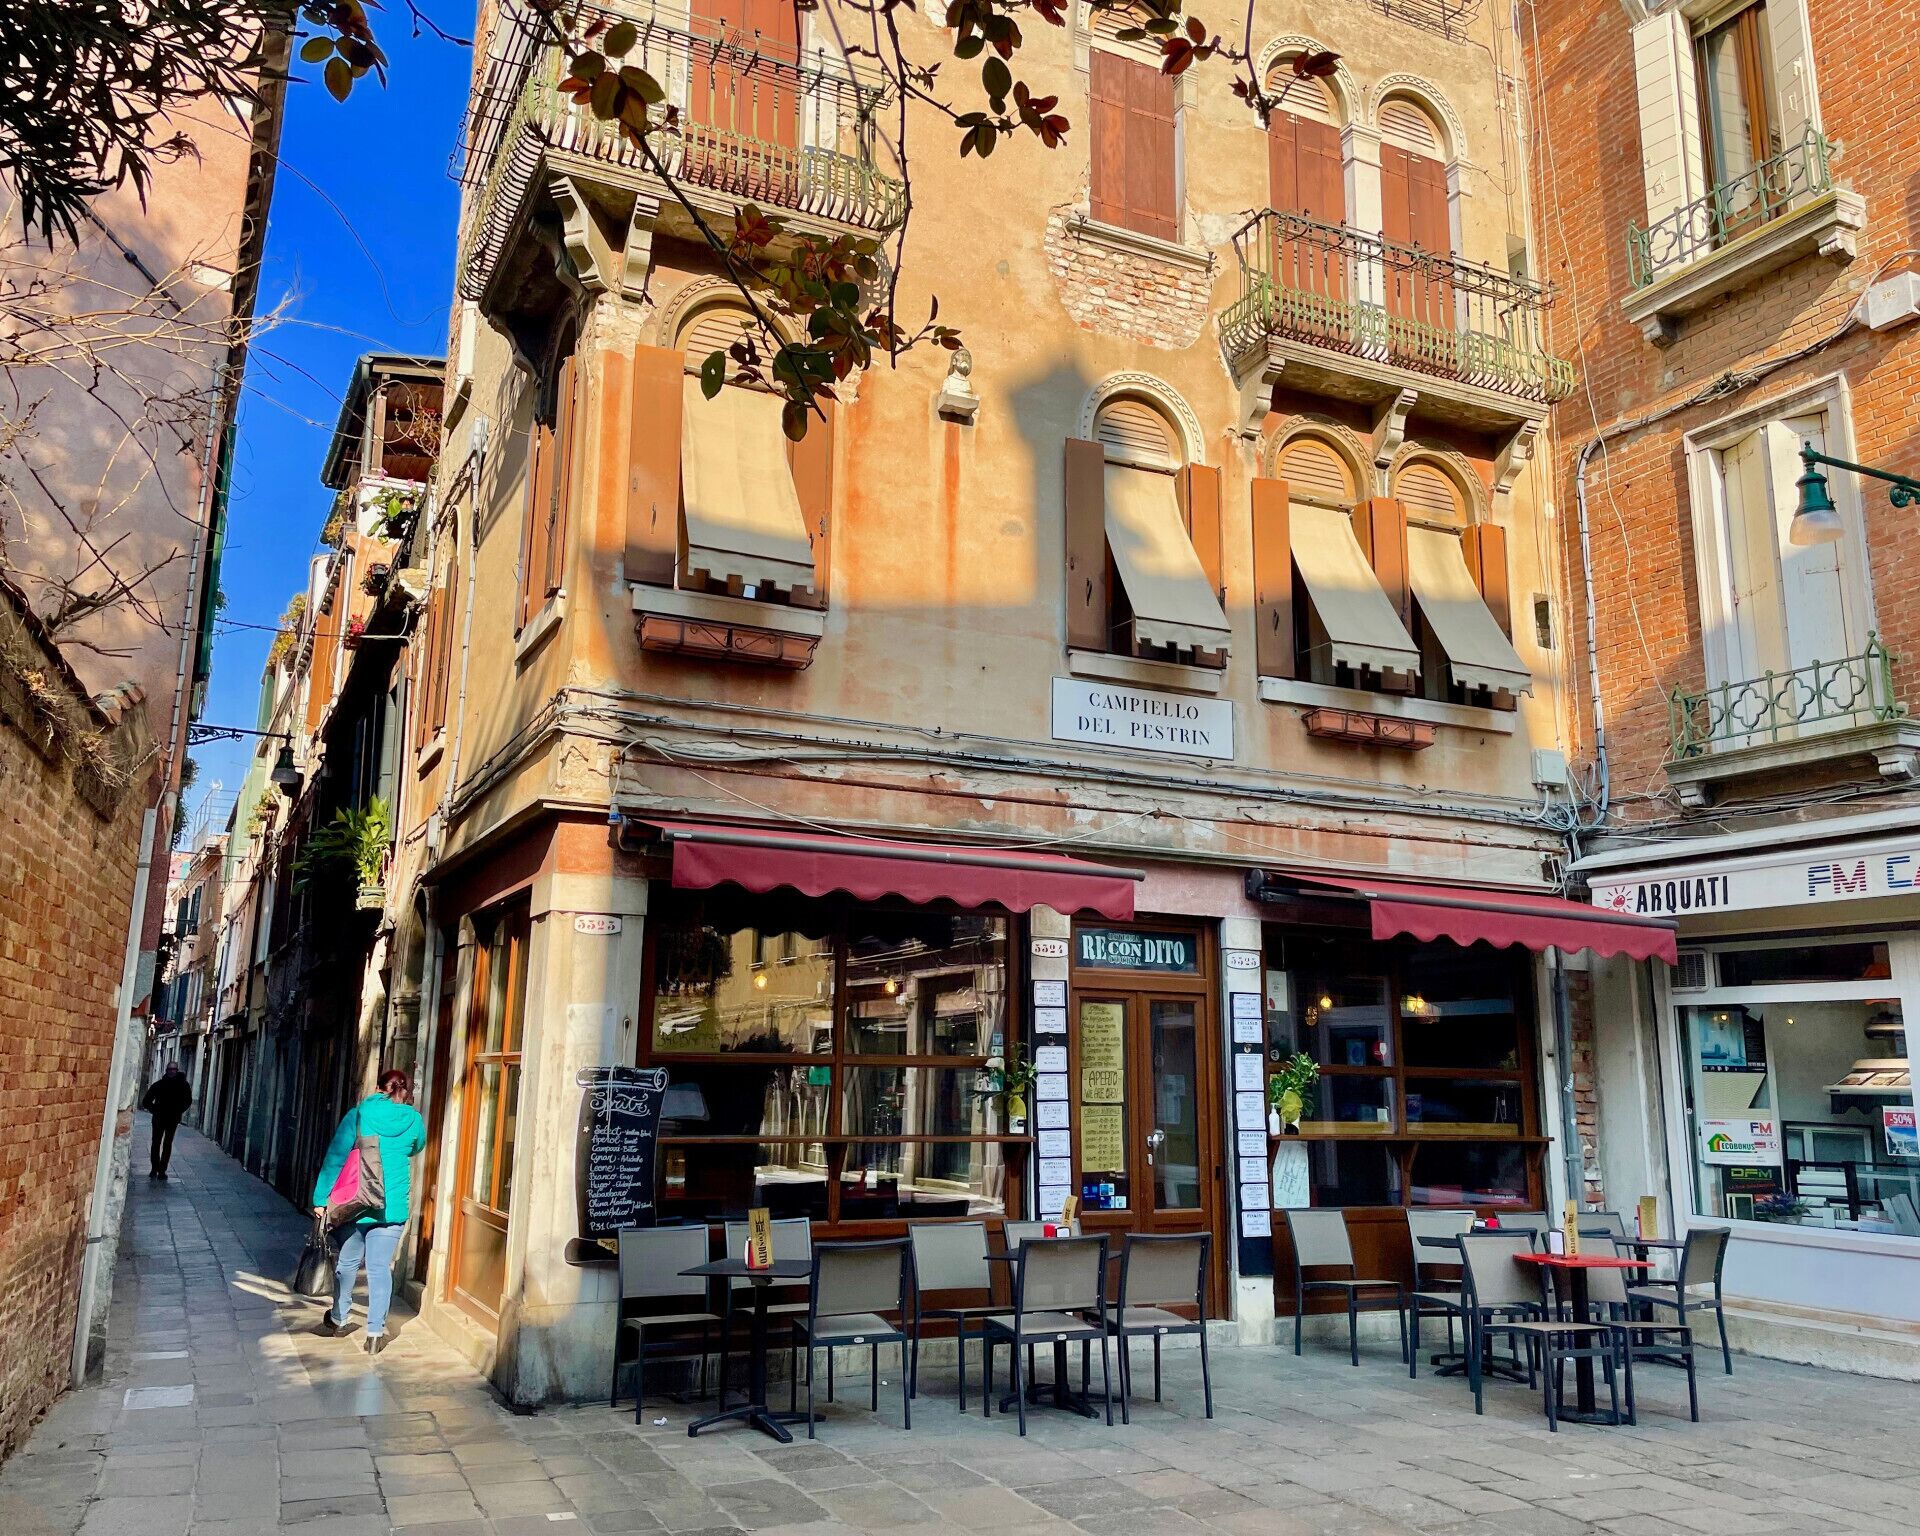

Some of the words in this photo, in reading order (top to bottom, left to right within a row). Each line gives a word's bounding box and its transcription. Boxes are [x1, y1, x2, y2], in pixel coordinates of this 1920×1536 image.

[1089, 692, 1199, 720] CAMPIELLO
[1078, 716, 1115, 735] DEL
[1131, 722, 1210, 746] PESTRIN
[1808, 860, 1867, 896] FM
[1636, 875, 1729, 913] ARQUATI
[1750, 1122, 1773, 1133] FM
[1890, 1113, 1913, 1124] -50%
[1721, 1142, 1756, 1150] ECOBONUS
